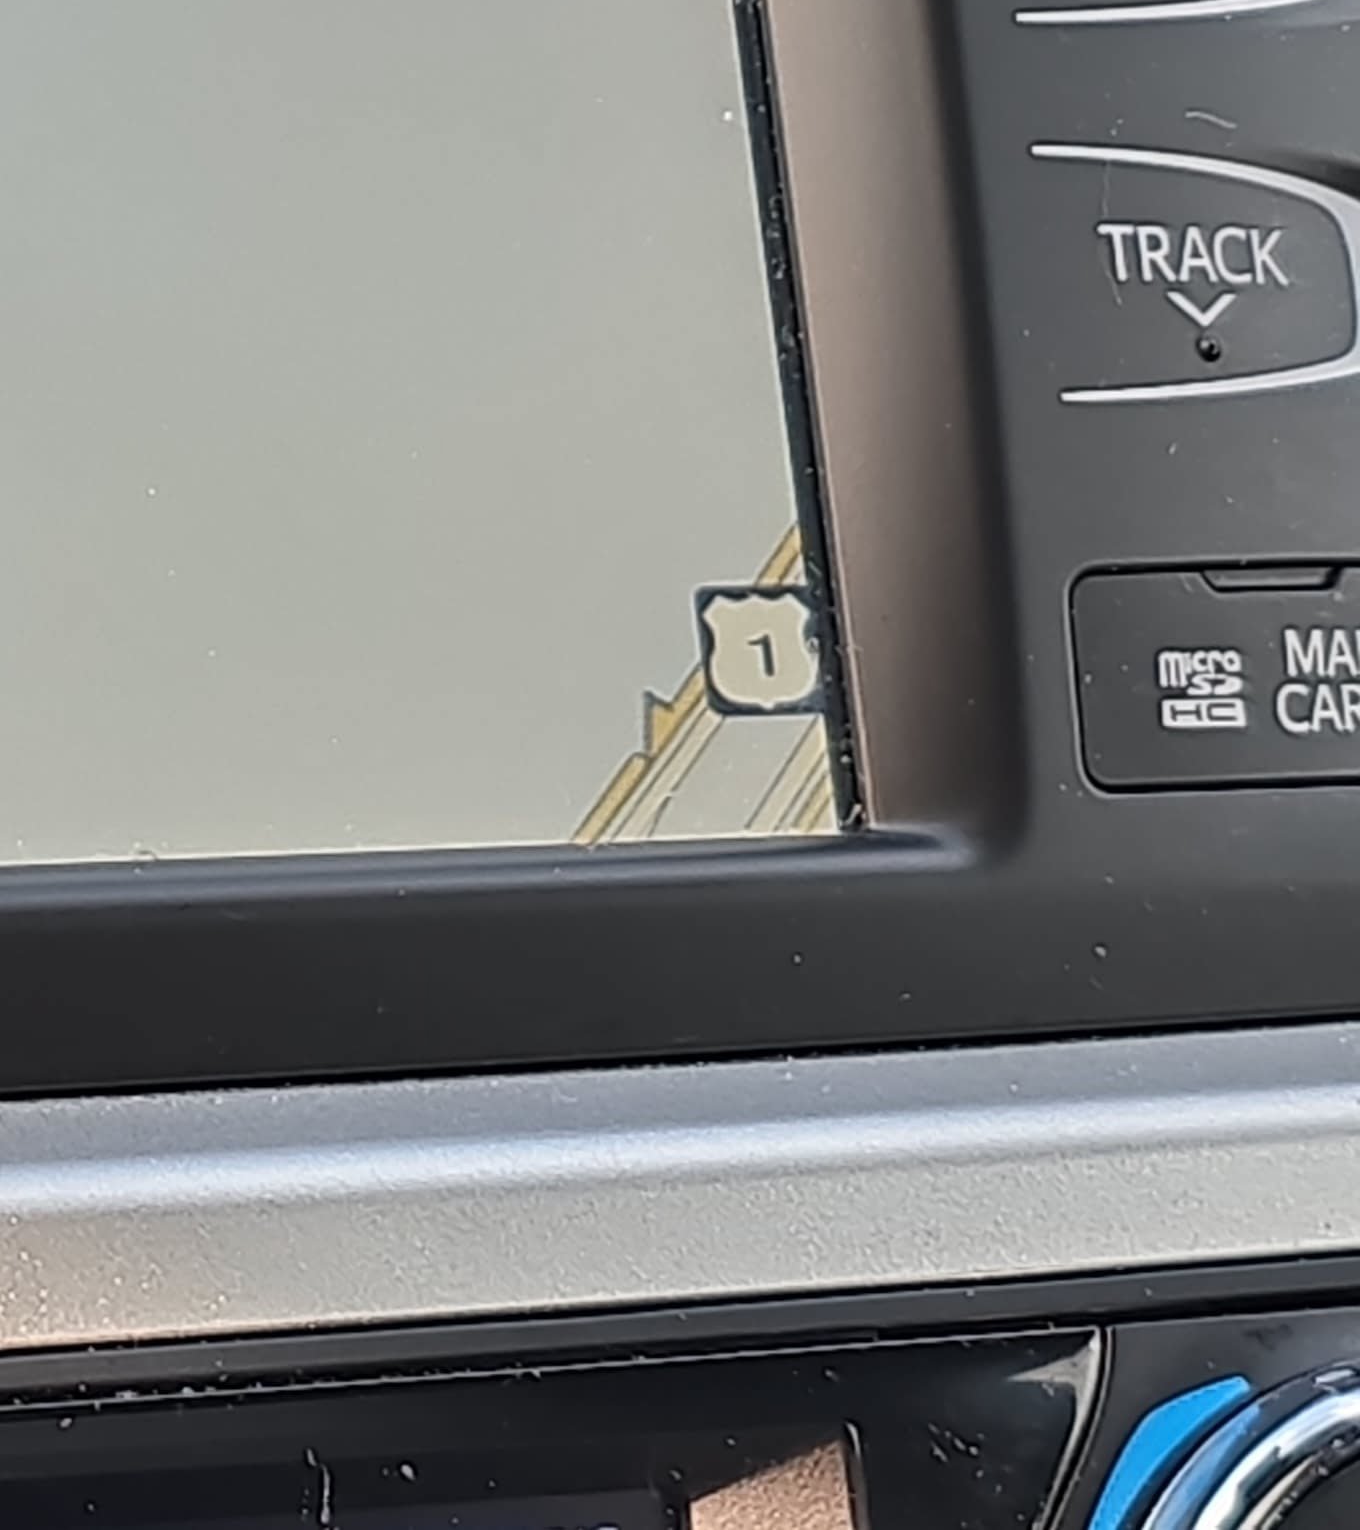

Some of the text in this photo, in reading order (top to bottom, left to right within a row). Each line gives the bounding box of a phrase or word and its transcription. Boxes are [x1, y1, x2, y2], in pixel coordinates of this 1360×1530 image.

[1096, 222, 1289, 287] TRACK
[746, 633, 776, 677] 1
[1157, 650, 1242, 689] micro
[1283, 628, 1360, 677] MA
[1166, 701, 1240, 725] HC
